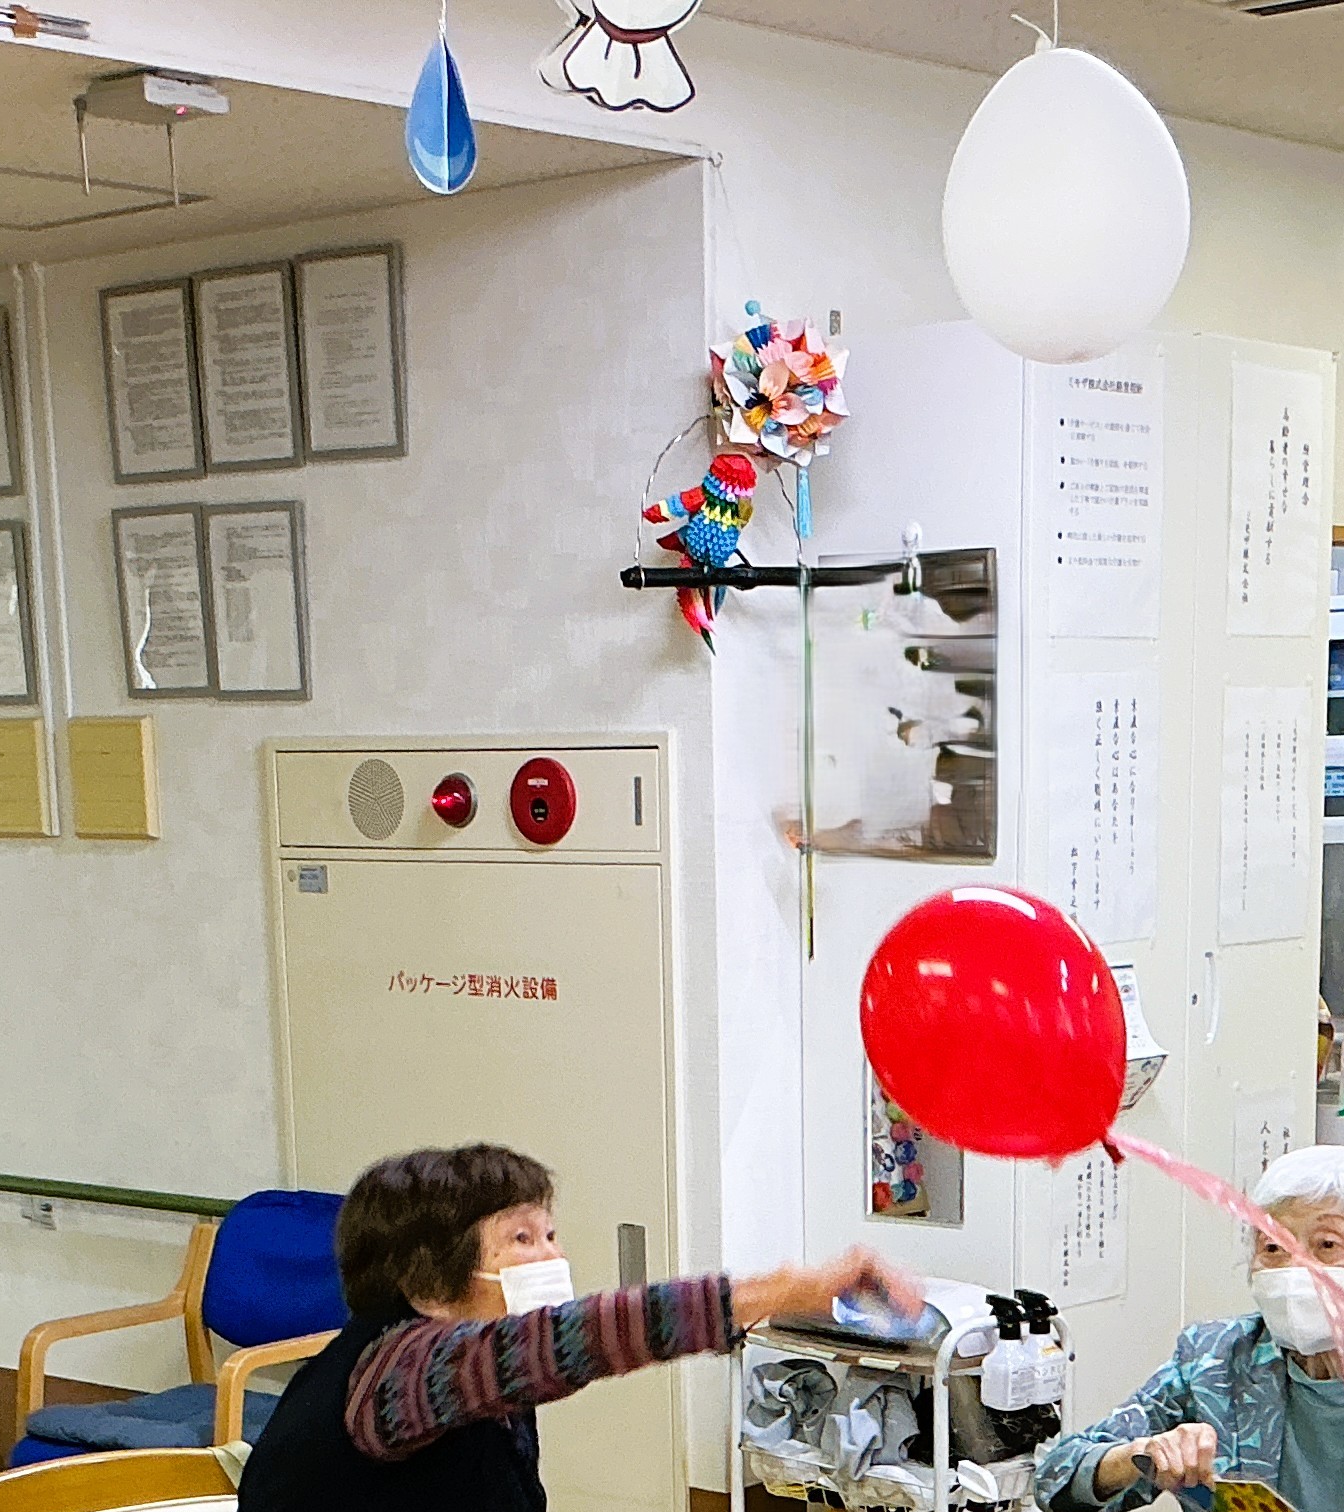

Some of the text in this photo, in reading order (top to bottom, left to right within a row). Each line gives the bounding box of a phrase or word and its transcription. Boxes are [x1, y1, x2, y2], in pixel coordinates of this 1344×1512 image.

[1092, 700, 1102, 911] 強く正しく聡明にいたします
[1111, 698, 1120, 845] 素直な心はあなたを
[1128, 698, 1138, 876] 素直な心になりましょう
[388, 969, 558, 1001] パッケージ型消火設備
